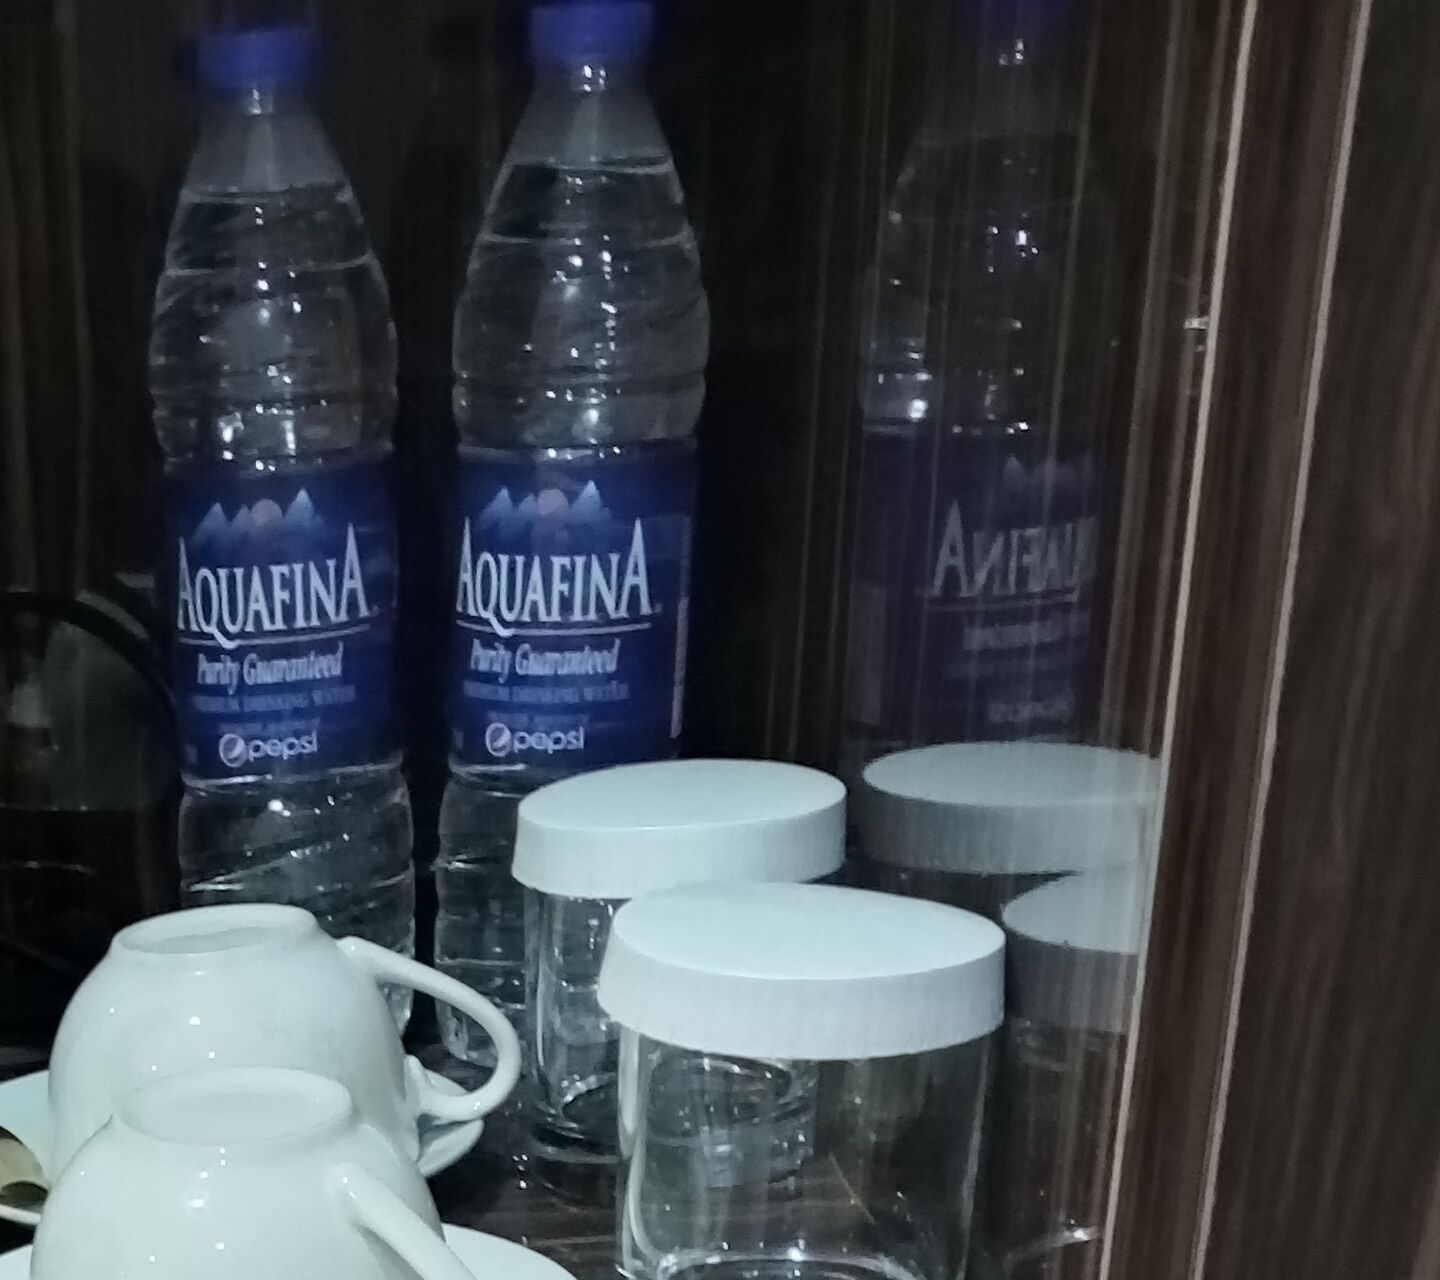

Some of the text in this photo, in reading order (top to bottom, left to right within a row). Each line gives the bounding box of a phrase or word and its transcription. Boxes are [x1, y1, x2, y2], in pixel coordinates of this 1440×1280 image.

[177, 523, 370, 649] AQUAFINA
[457, 516, 652, 637] AQUAFINA
[197, 641, 344, 695] Purity Guaranteed
[515, 638, 622, 676] Guaranteed
[248, 730, 318, 761] pepsi
[512, 726, 585, 755] pepsi
